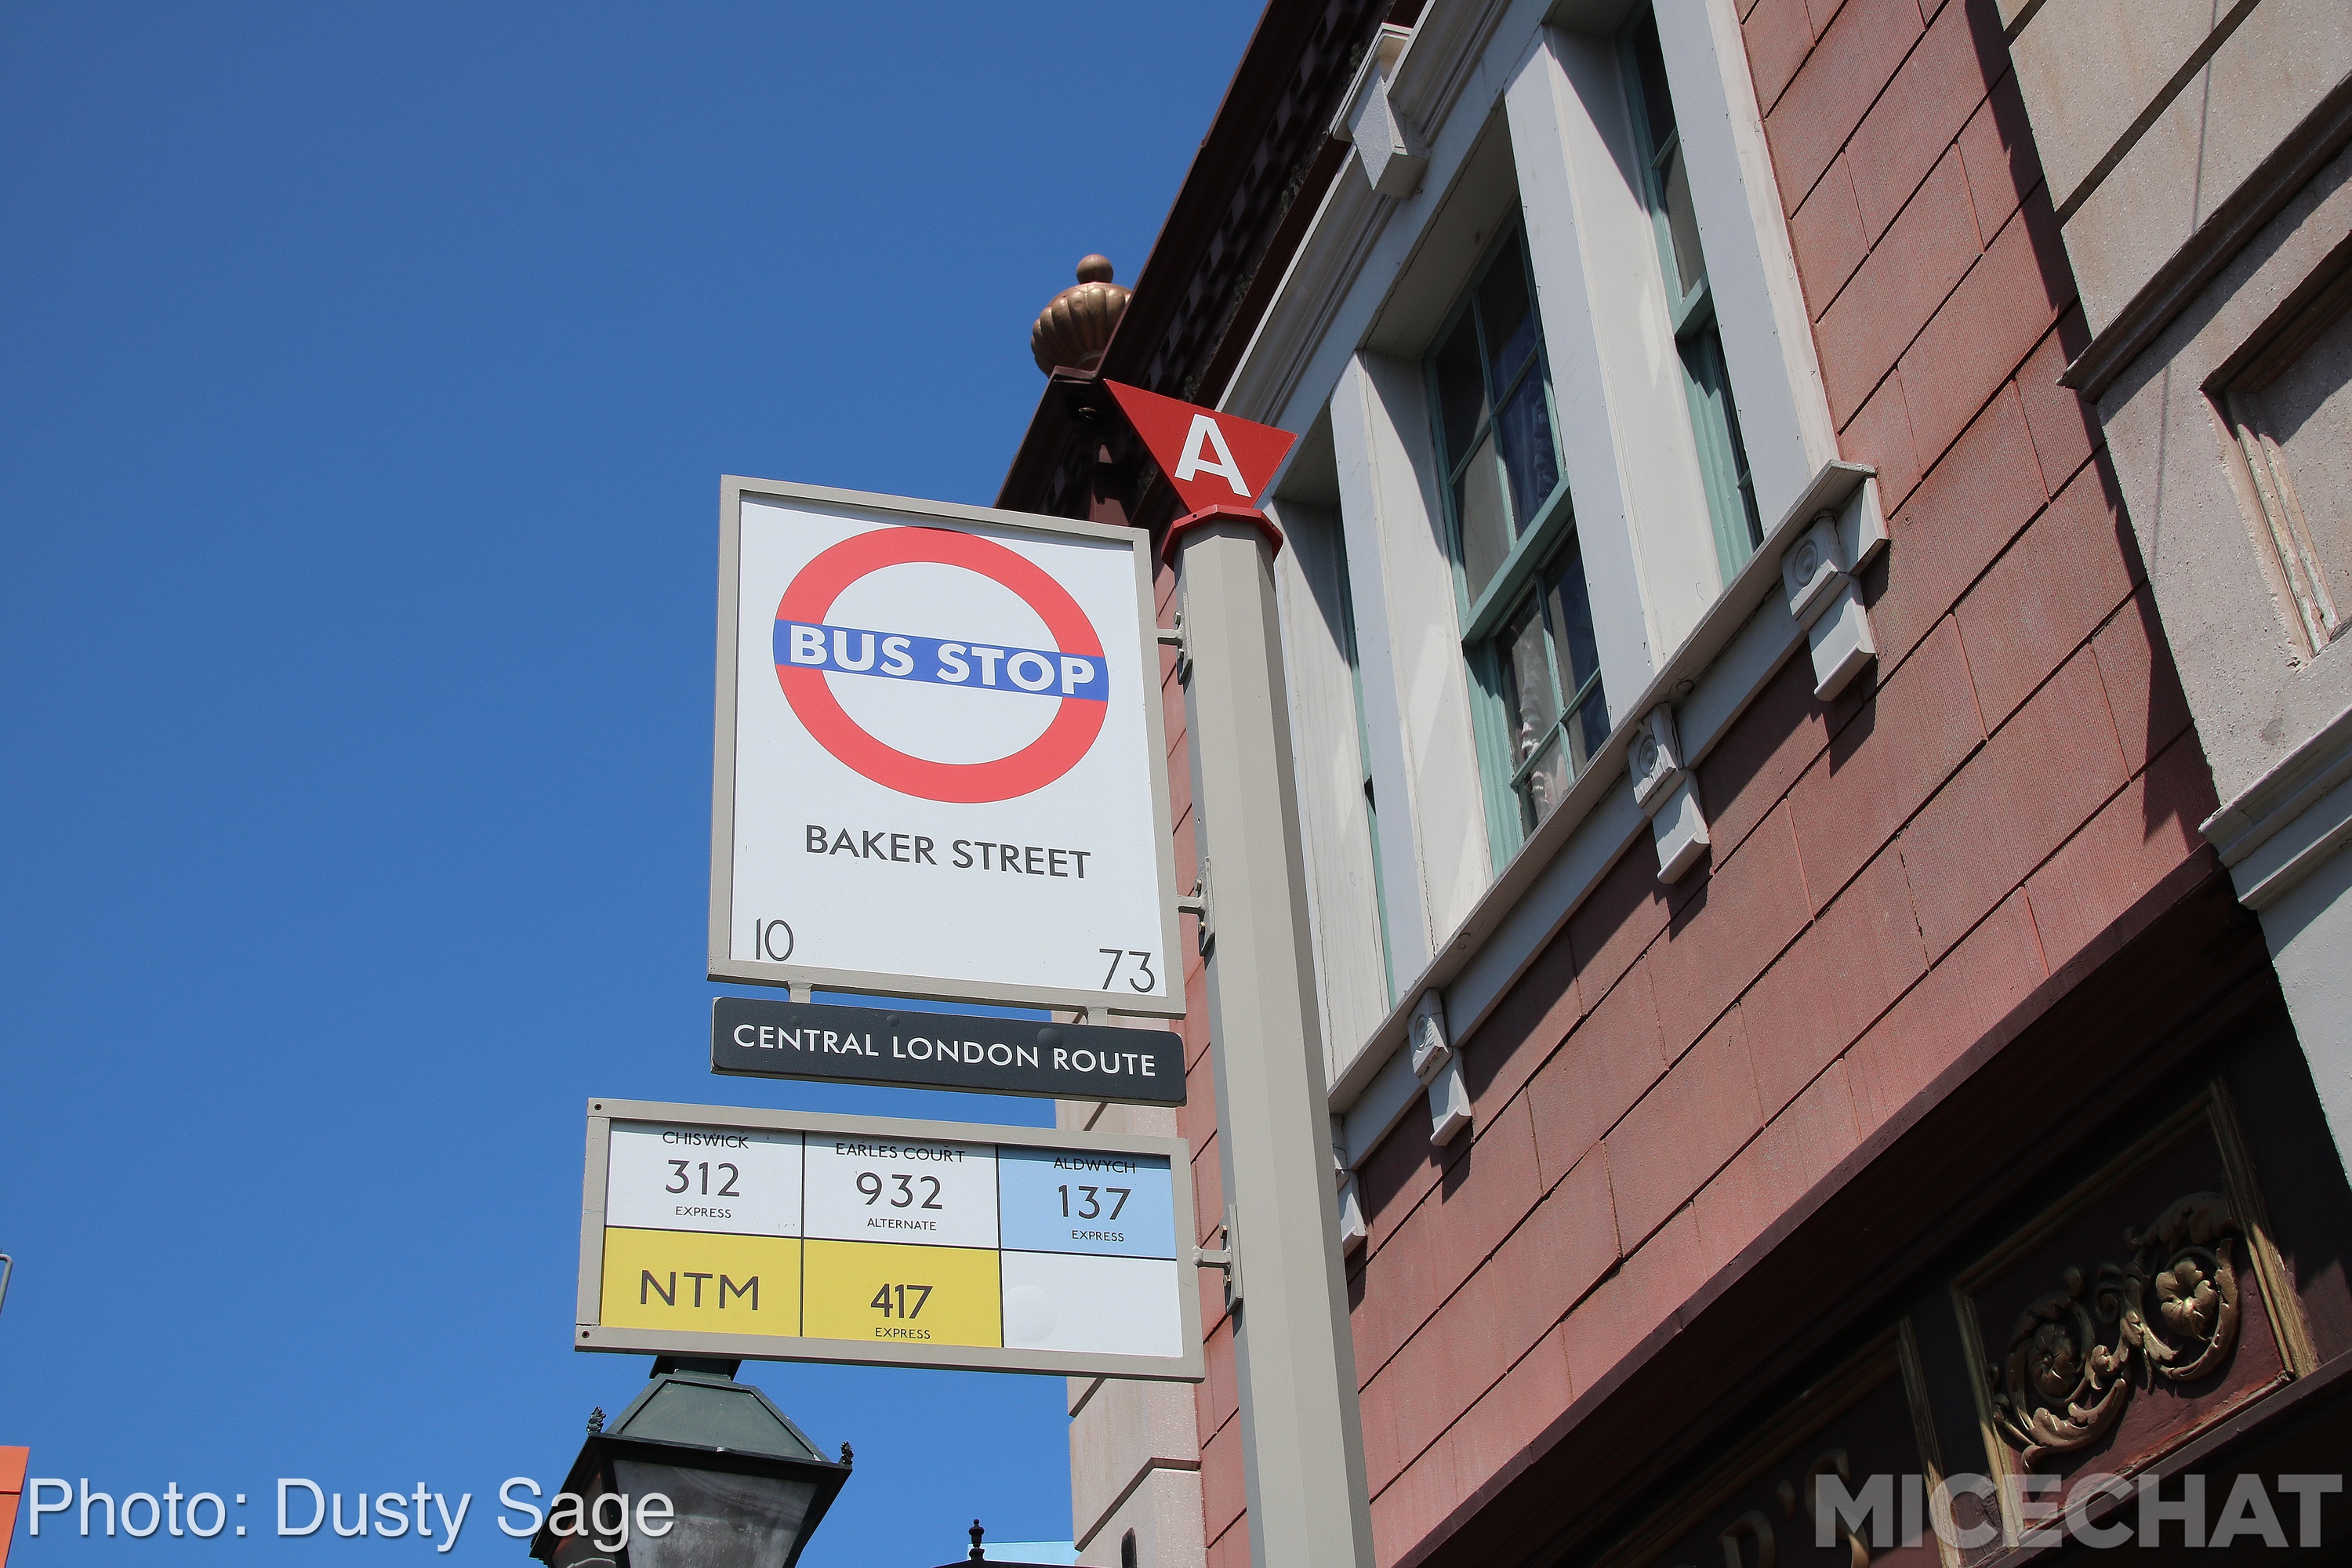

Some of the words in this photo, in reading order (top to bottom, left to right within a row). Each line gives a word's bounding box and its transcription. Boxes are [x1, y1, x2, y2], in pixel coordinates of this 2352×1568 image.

[1174, 413, 1252, 498] A
[789, 625, 916, 677] BUS
[936, 643, 1095, 695] STOP
[805, 825, 937, 865] BAKER
[951, 840, 1091, 879] STREET
[756, 918, 794, 962] 10
[1099, 949, 1156, 993] 73
[733, 1024, 880, 1058] CENTRAL
[892, 1036, 1039, 1069] LONDON
[1053, 1048, 1157, 1077] ROUTE
[662, 1131, 750, 1149] CHISWICK
[836, 1142, 898, 1159] EARLES
[903, 1147, 966, 1163] COURT
[665, 1159, 740, 1197] 312
[1054, 1157, 1136, 1174] ALDWYCH
[856, 1171, 943, 1210] 932
[1058, 1185, 1132, 1221] 137
[675, 1206, 731, 1219] EXPRESS
[866, 1218, 937, 1231] ALTERNATE
[1072, 1229, 1124, 1242] EXPRESS
[640, 1269, 760, 1312] NTM
[870, 1283, 934, 1319] 417
[875, 1327, 931, 1340] EXPRESS
